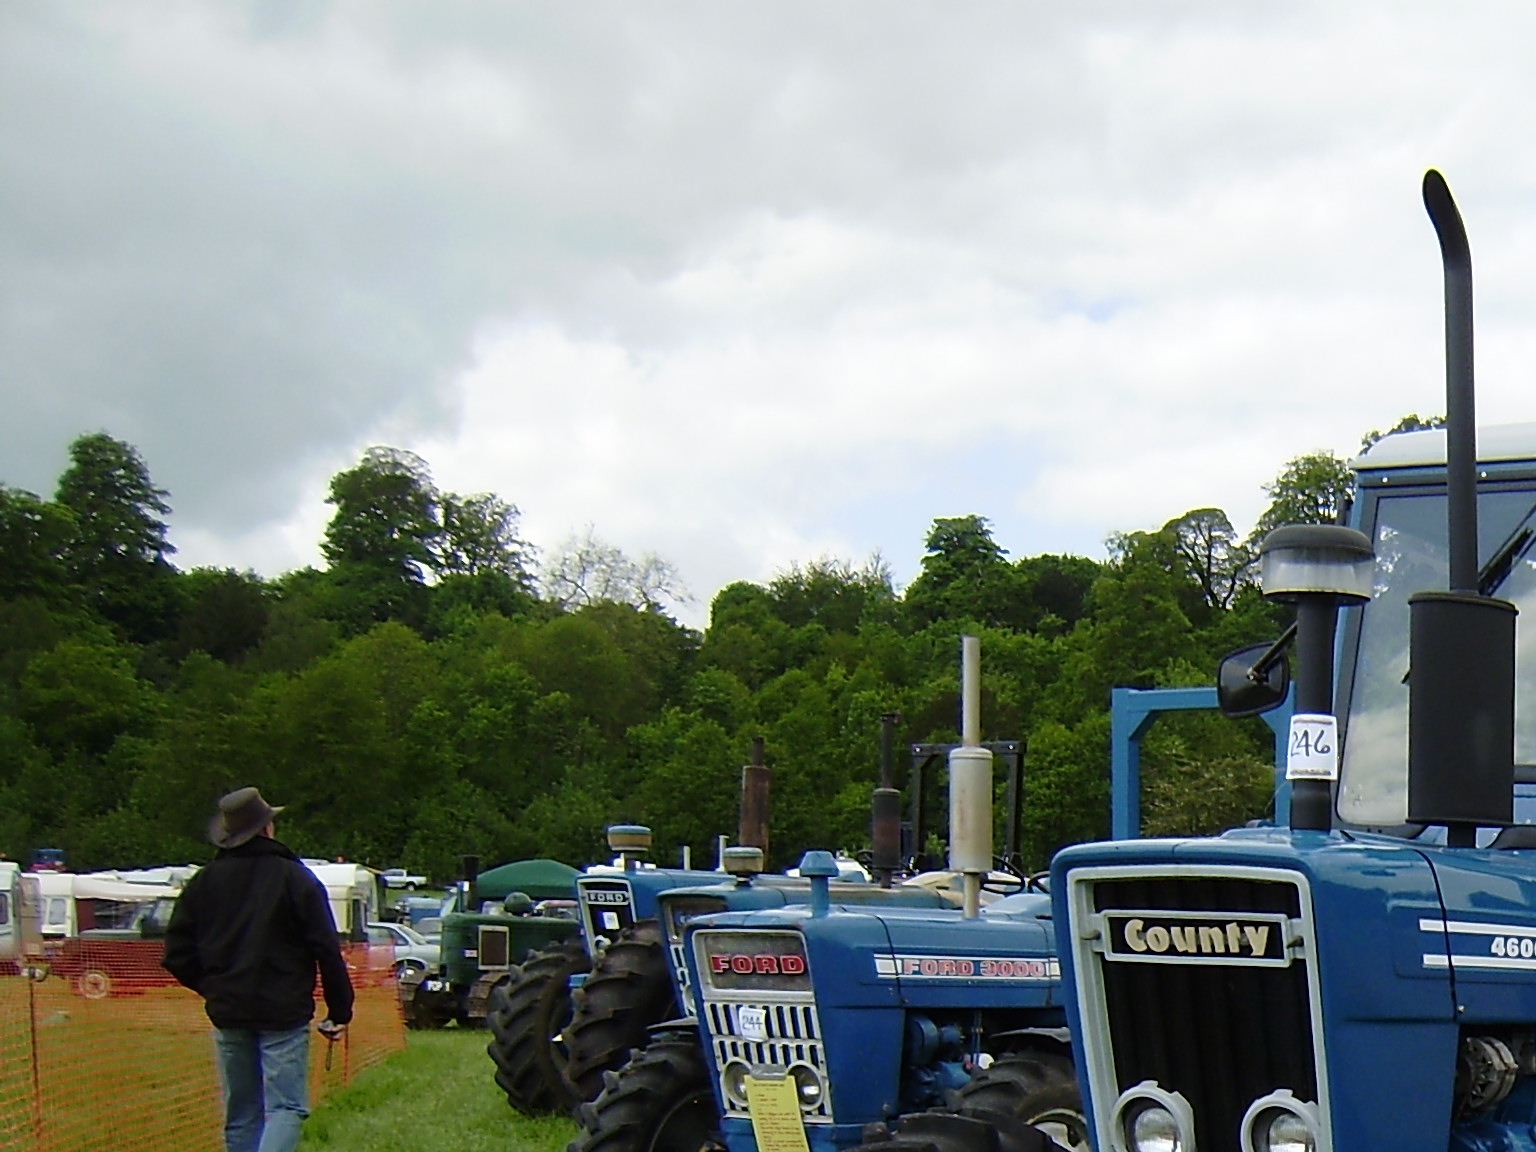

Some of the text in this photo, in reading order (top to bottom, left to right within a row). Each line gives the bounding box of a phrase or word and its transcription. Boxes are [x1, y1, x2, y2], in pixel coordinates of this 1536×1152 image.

[1291, 730, 1331, 757] 246
[589, 893, 624, 902] FORD
[1124, 919, 1269, 956] County
[711, 954, 804, 974] FORD
[904, 959, 1045, 977] FORD 3000
